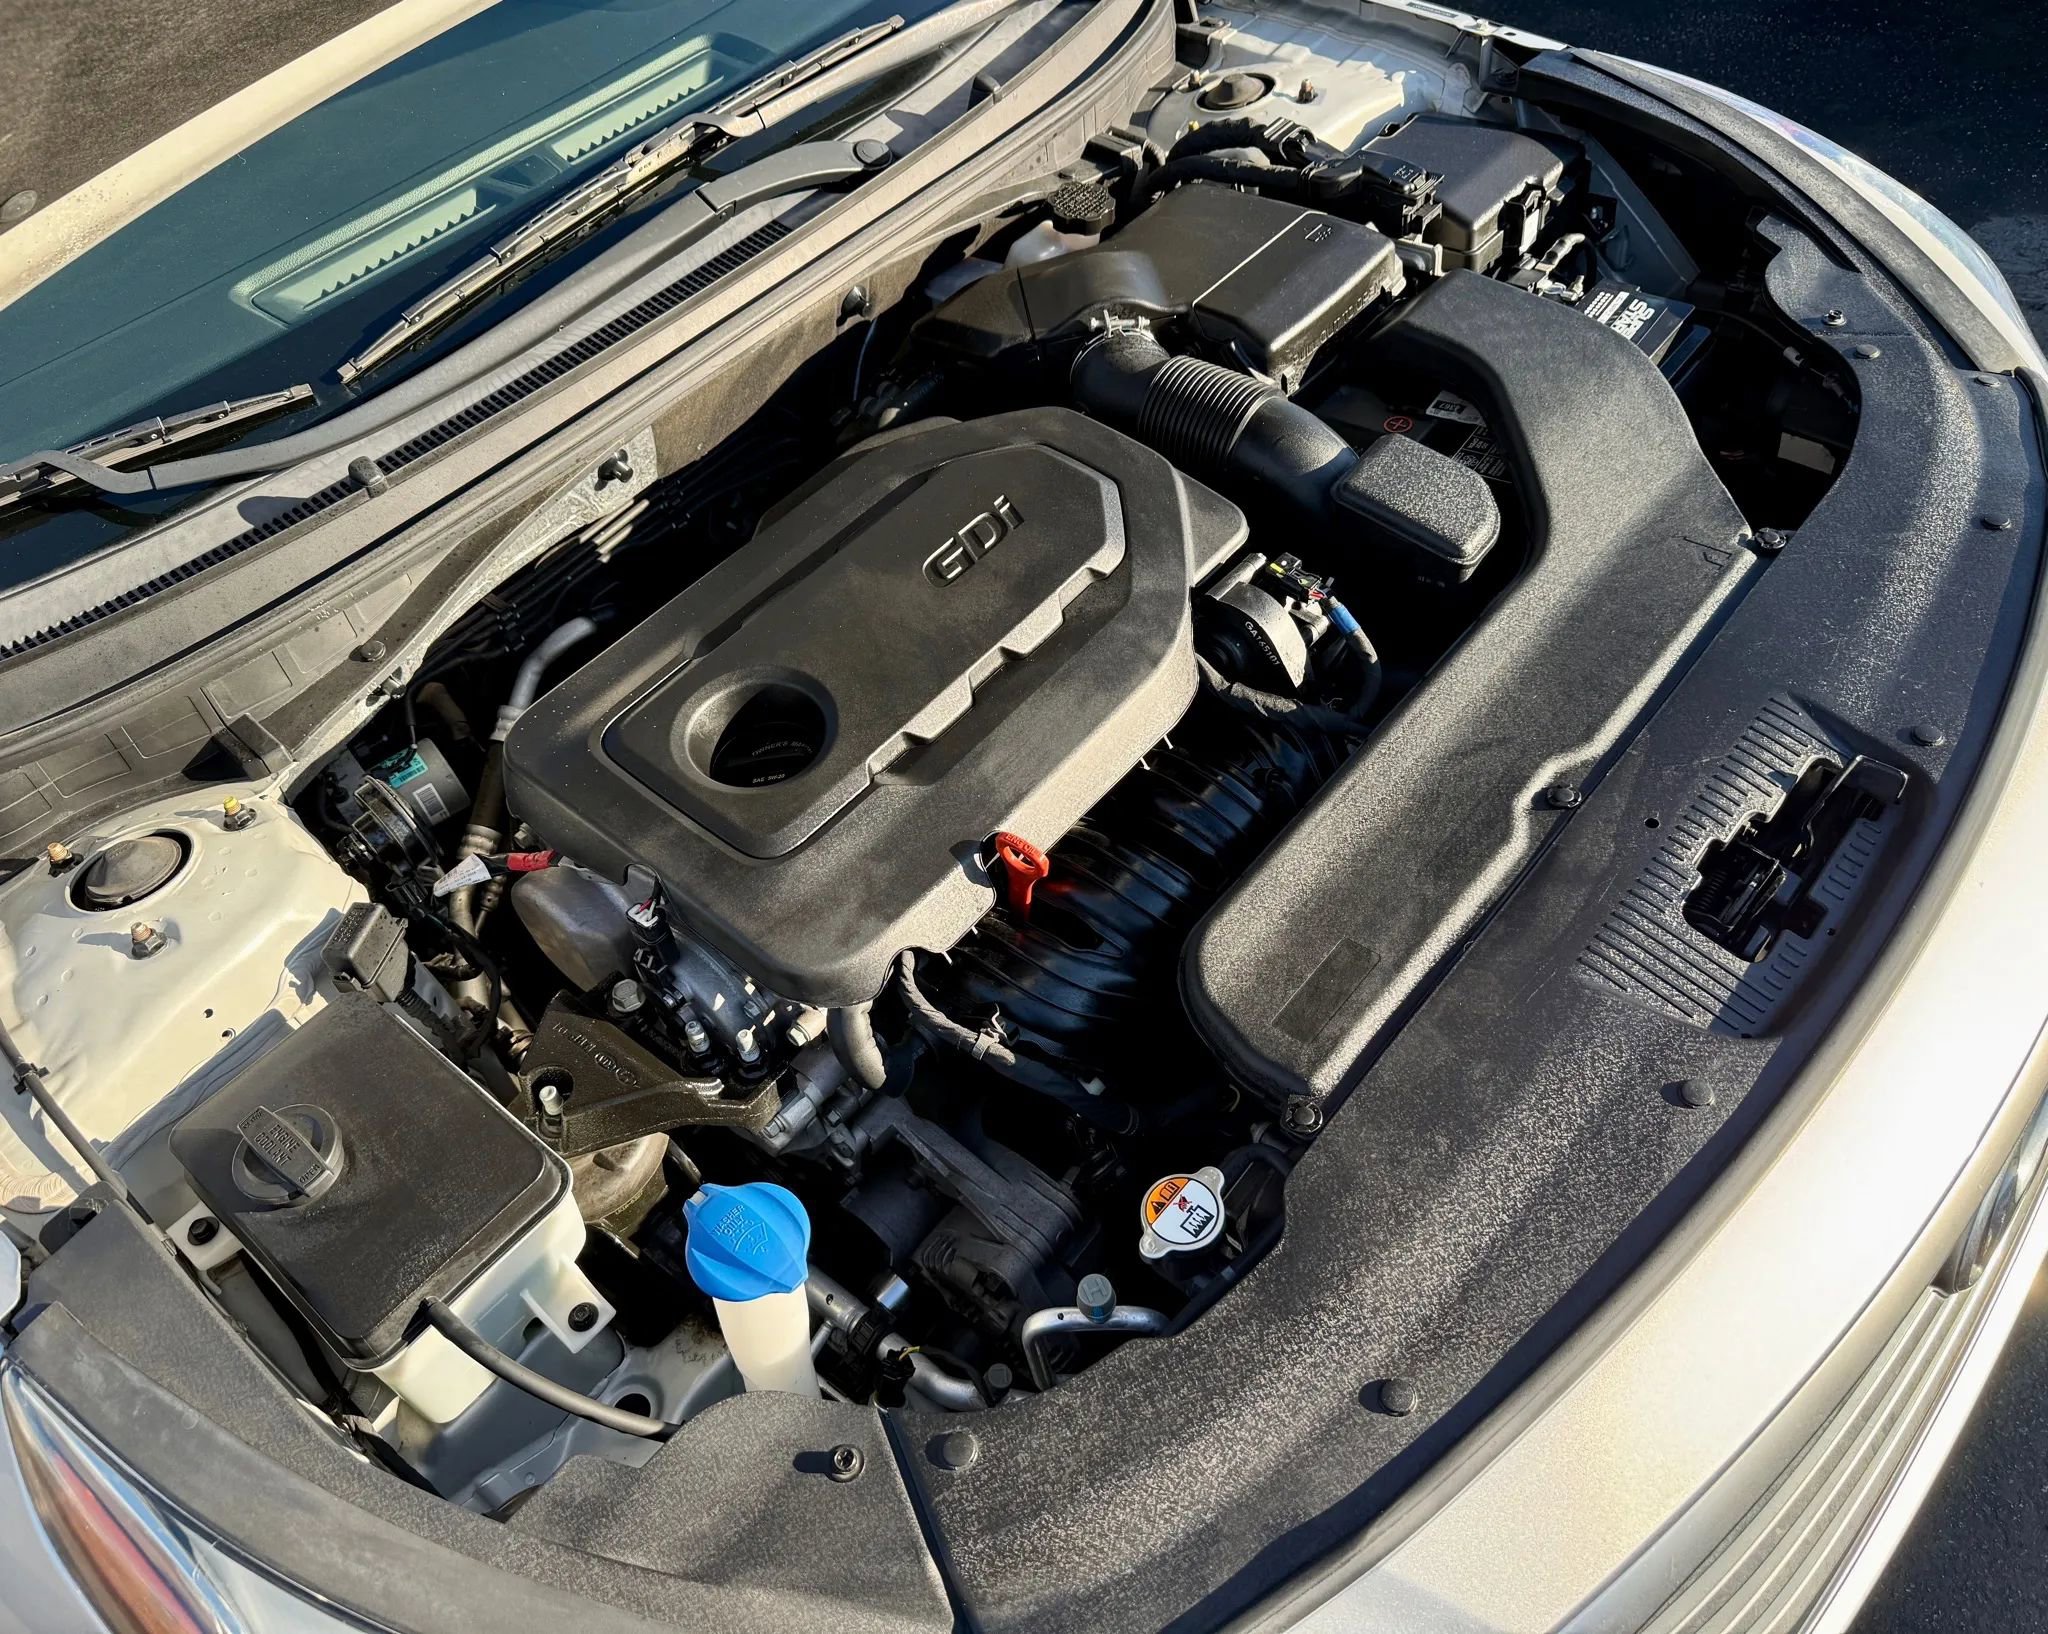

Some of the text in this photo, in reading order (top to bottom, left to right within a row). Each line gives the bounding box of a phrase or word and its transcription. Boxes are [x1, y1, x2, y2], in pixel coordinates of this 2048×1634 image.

[922, 493, 1024, 588] GDi
[254, 1131, 292, 1167] COOLANT
[268, 1123, 300, 1154] ENGINE
[1082, 1277, 1108, 1303] H
